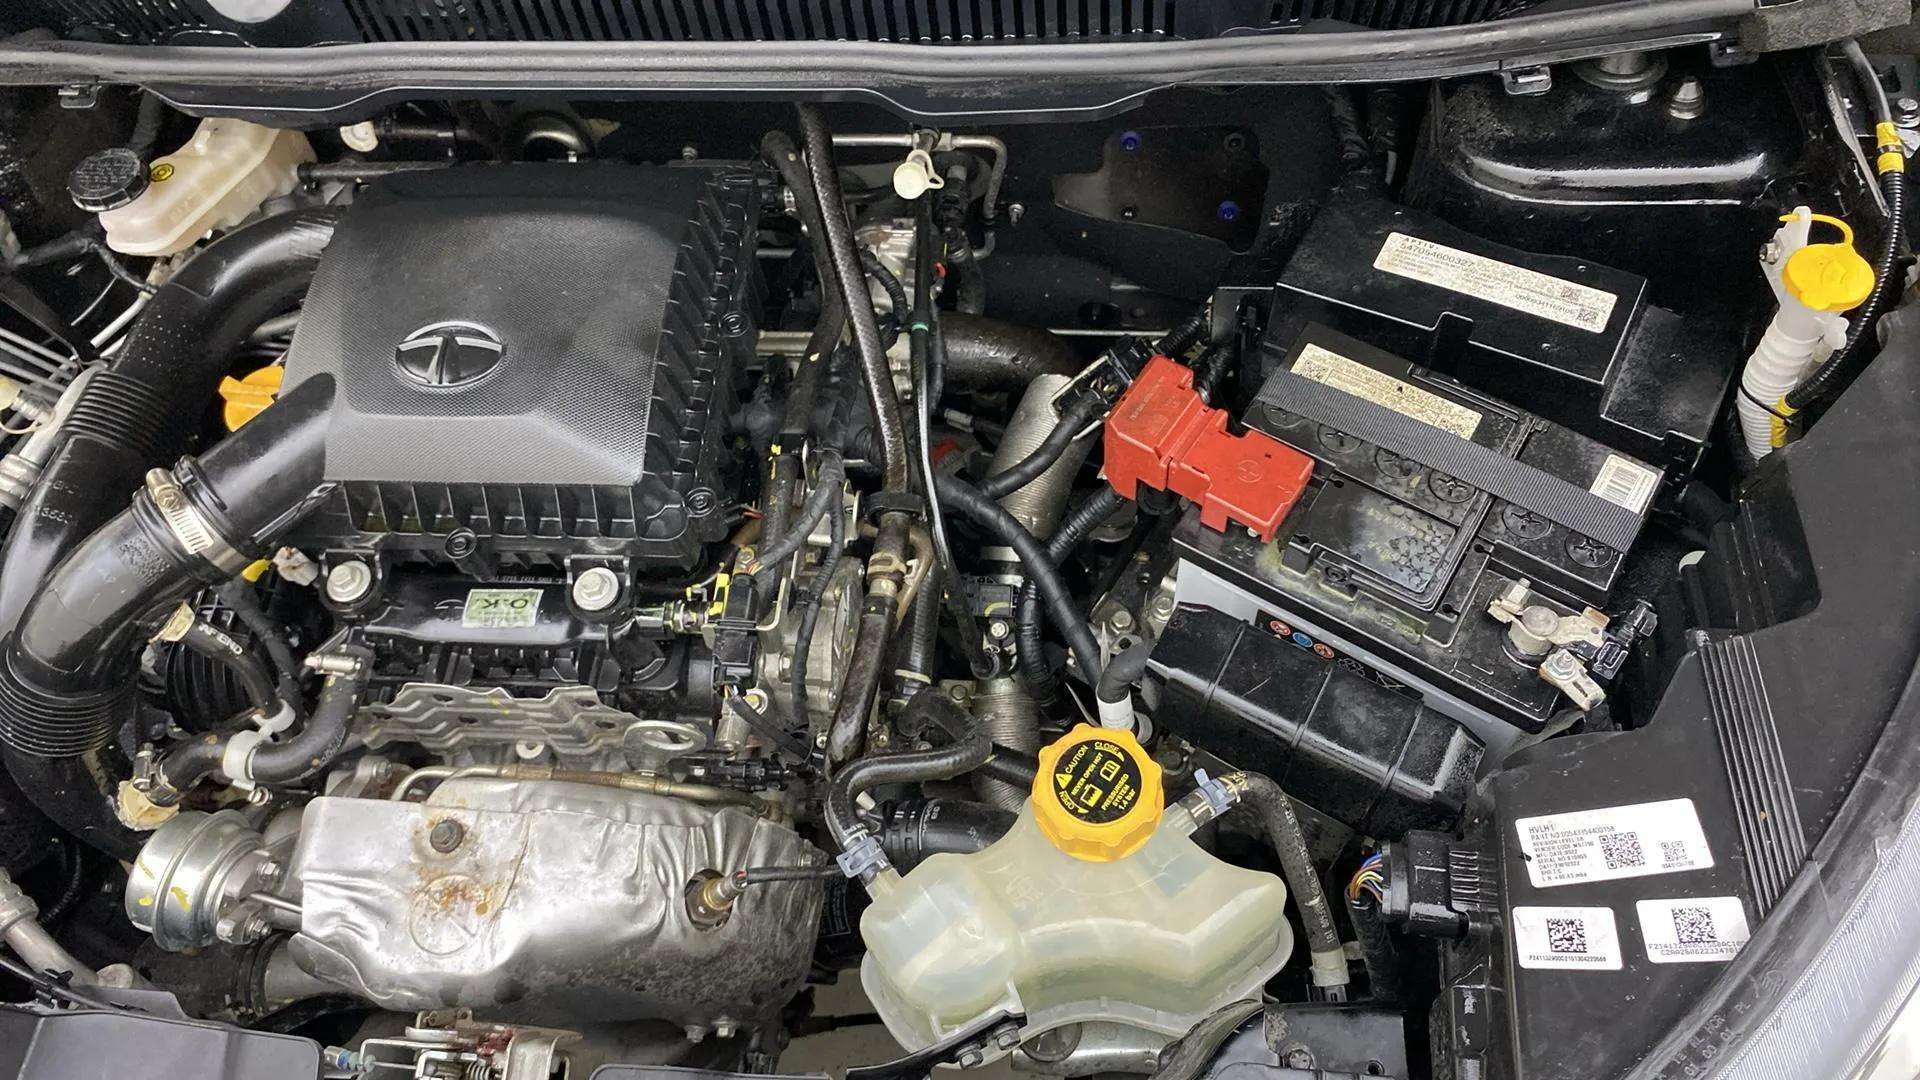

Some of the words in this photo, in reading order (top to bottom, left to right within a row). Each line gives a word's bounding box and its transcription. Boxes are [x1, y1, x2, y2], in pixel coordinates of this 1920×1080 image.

[216, 632, 243, 655] END
[1065, 744, 1089, 774] CAUTION
[1094, 741, 1121, 754] CLOSE
[1071, 777, 1086, 796] NEVER
[1083, 763, 1096, 779] OPEN
[1093, 752, 1103, 765] HOT
[1059, 791, 1075, 810] OPEN
[1101, 773, 1129, 811] PRESSURISED
[1112, 784, 1130, 807] SYSTEM
[1118, 799, 1129, 810] 1.4
[1125, 788, 1136, 801] bar
